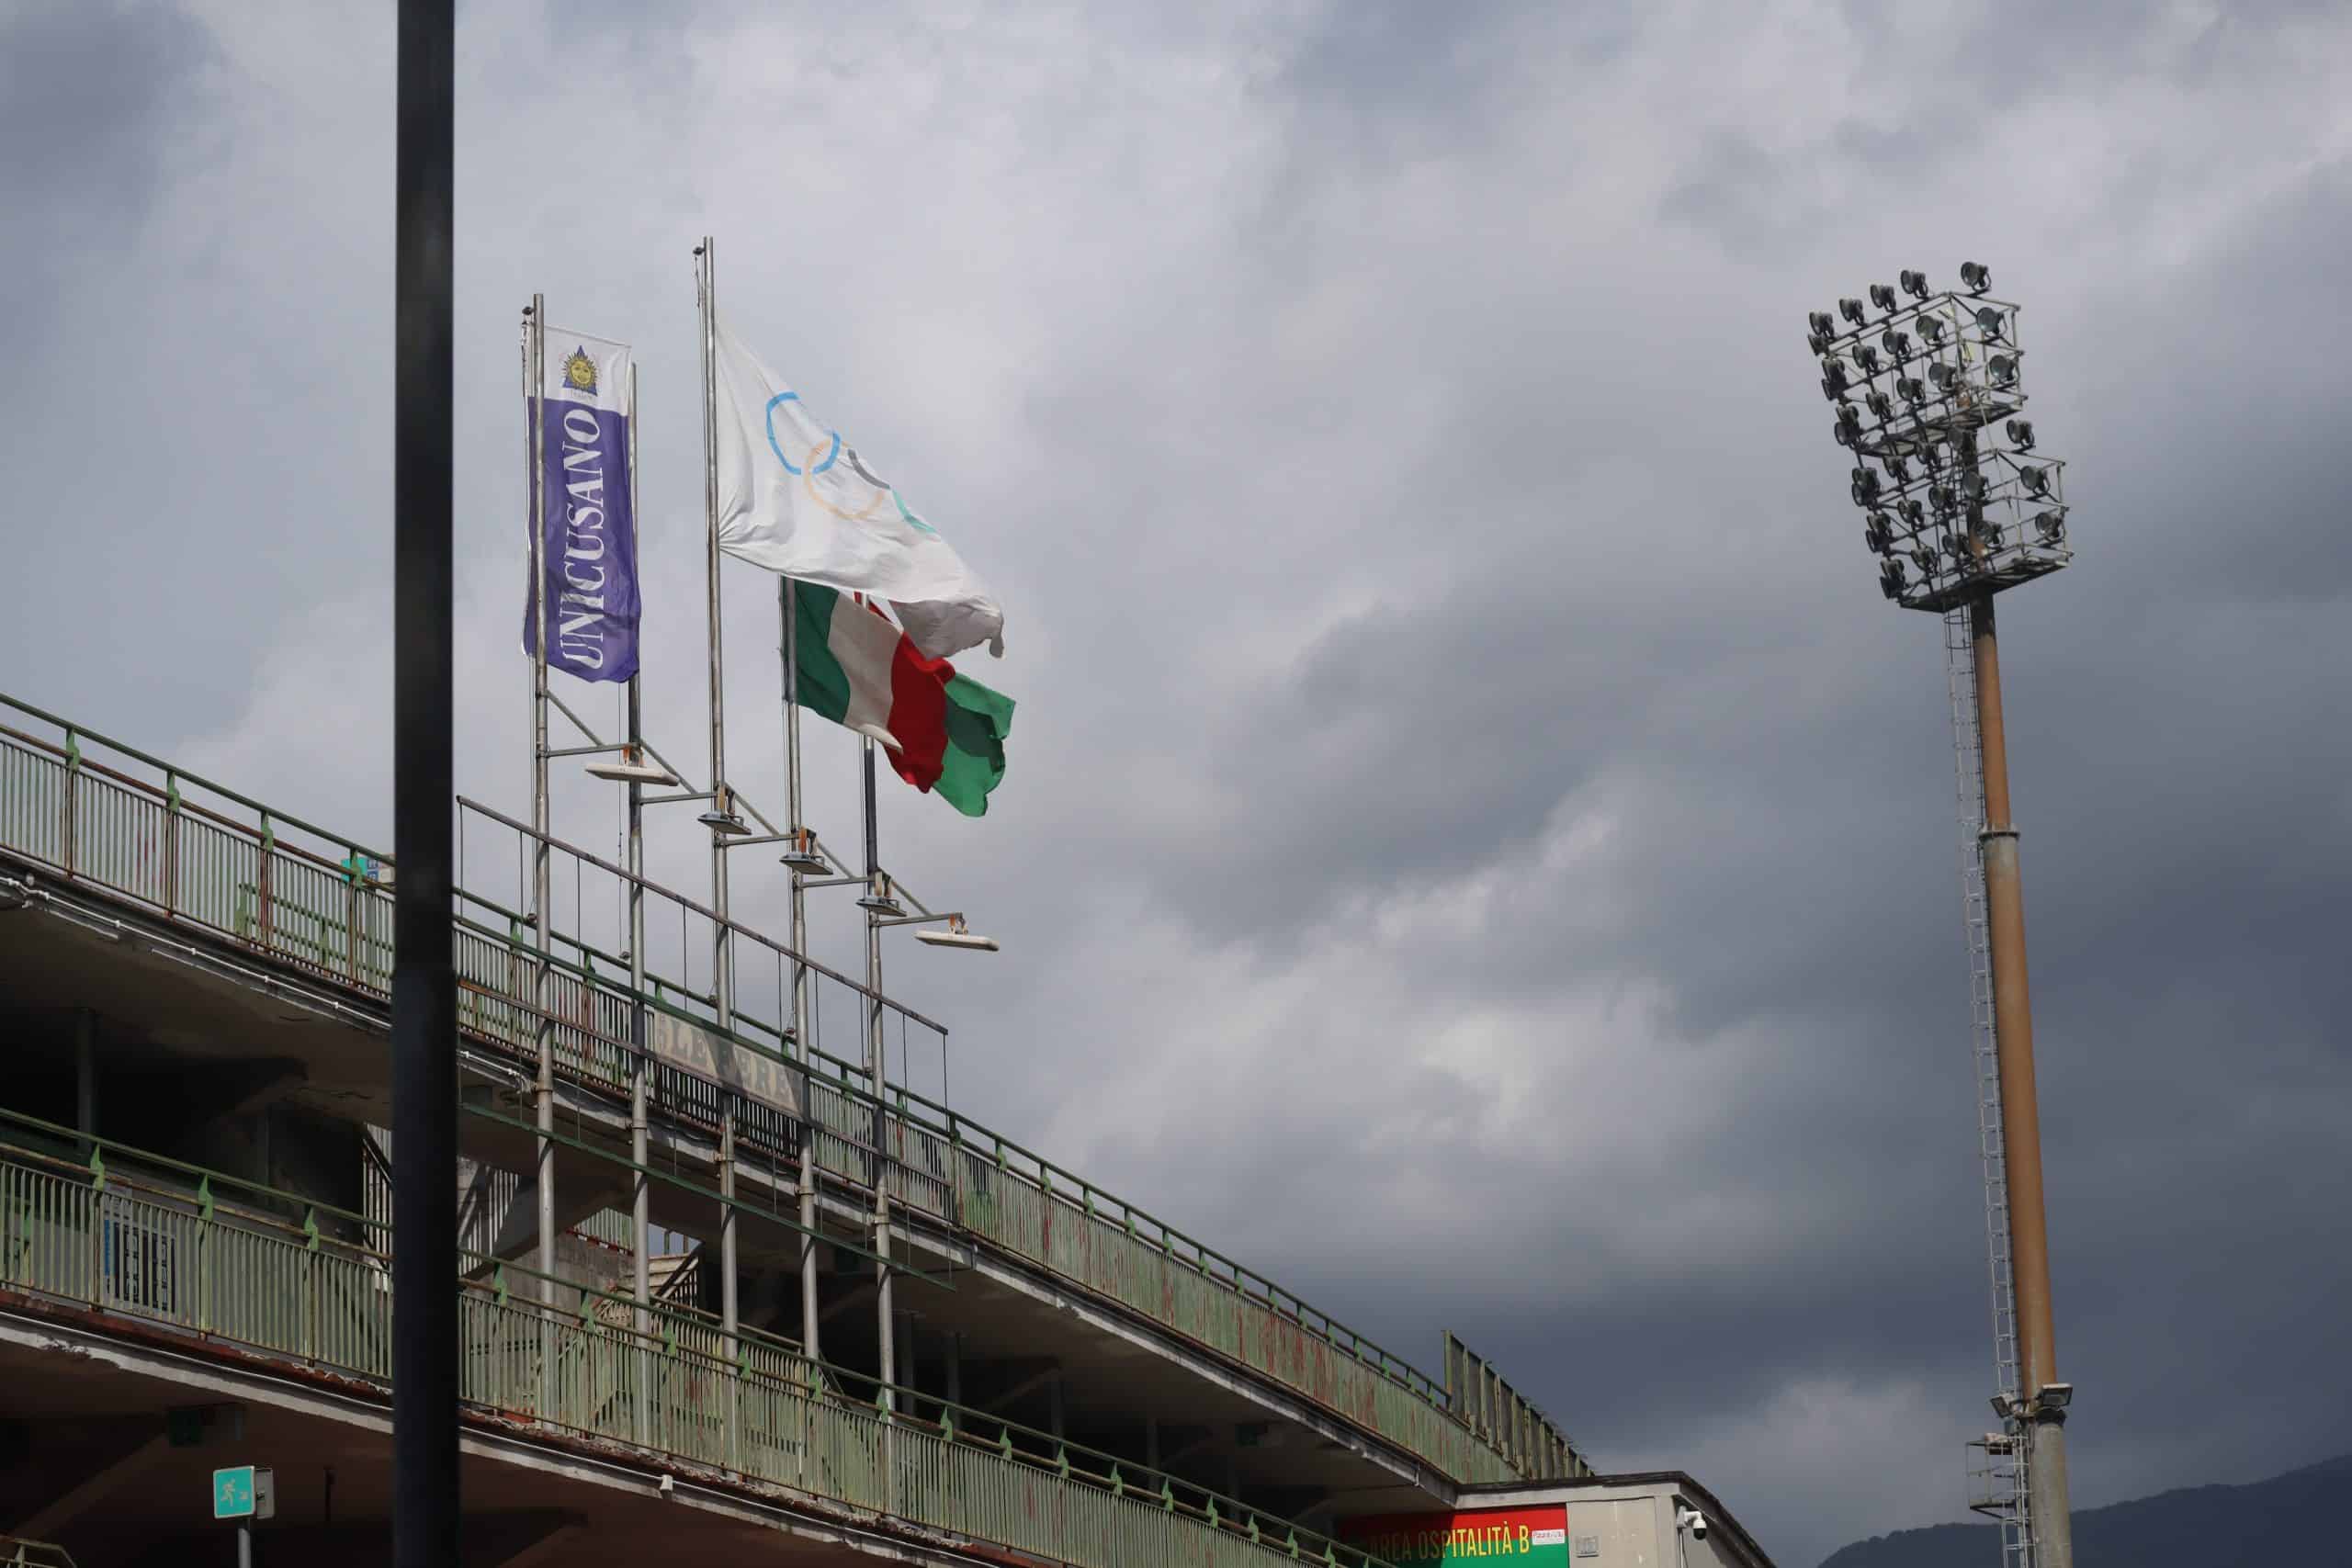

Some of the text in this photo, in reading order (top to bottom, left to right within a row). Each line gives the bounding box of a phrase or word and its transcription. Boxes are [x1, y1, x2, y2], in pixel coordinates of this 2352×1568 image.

[560, 409, 604, 670] UNICUSANO
[1369, 1531, 1412, 1562] AREA
[1419, 1521, 1513, 1560] OSPITALITÀ
[1519, 1525, 1531, 1553] B
